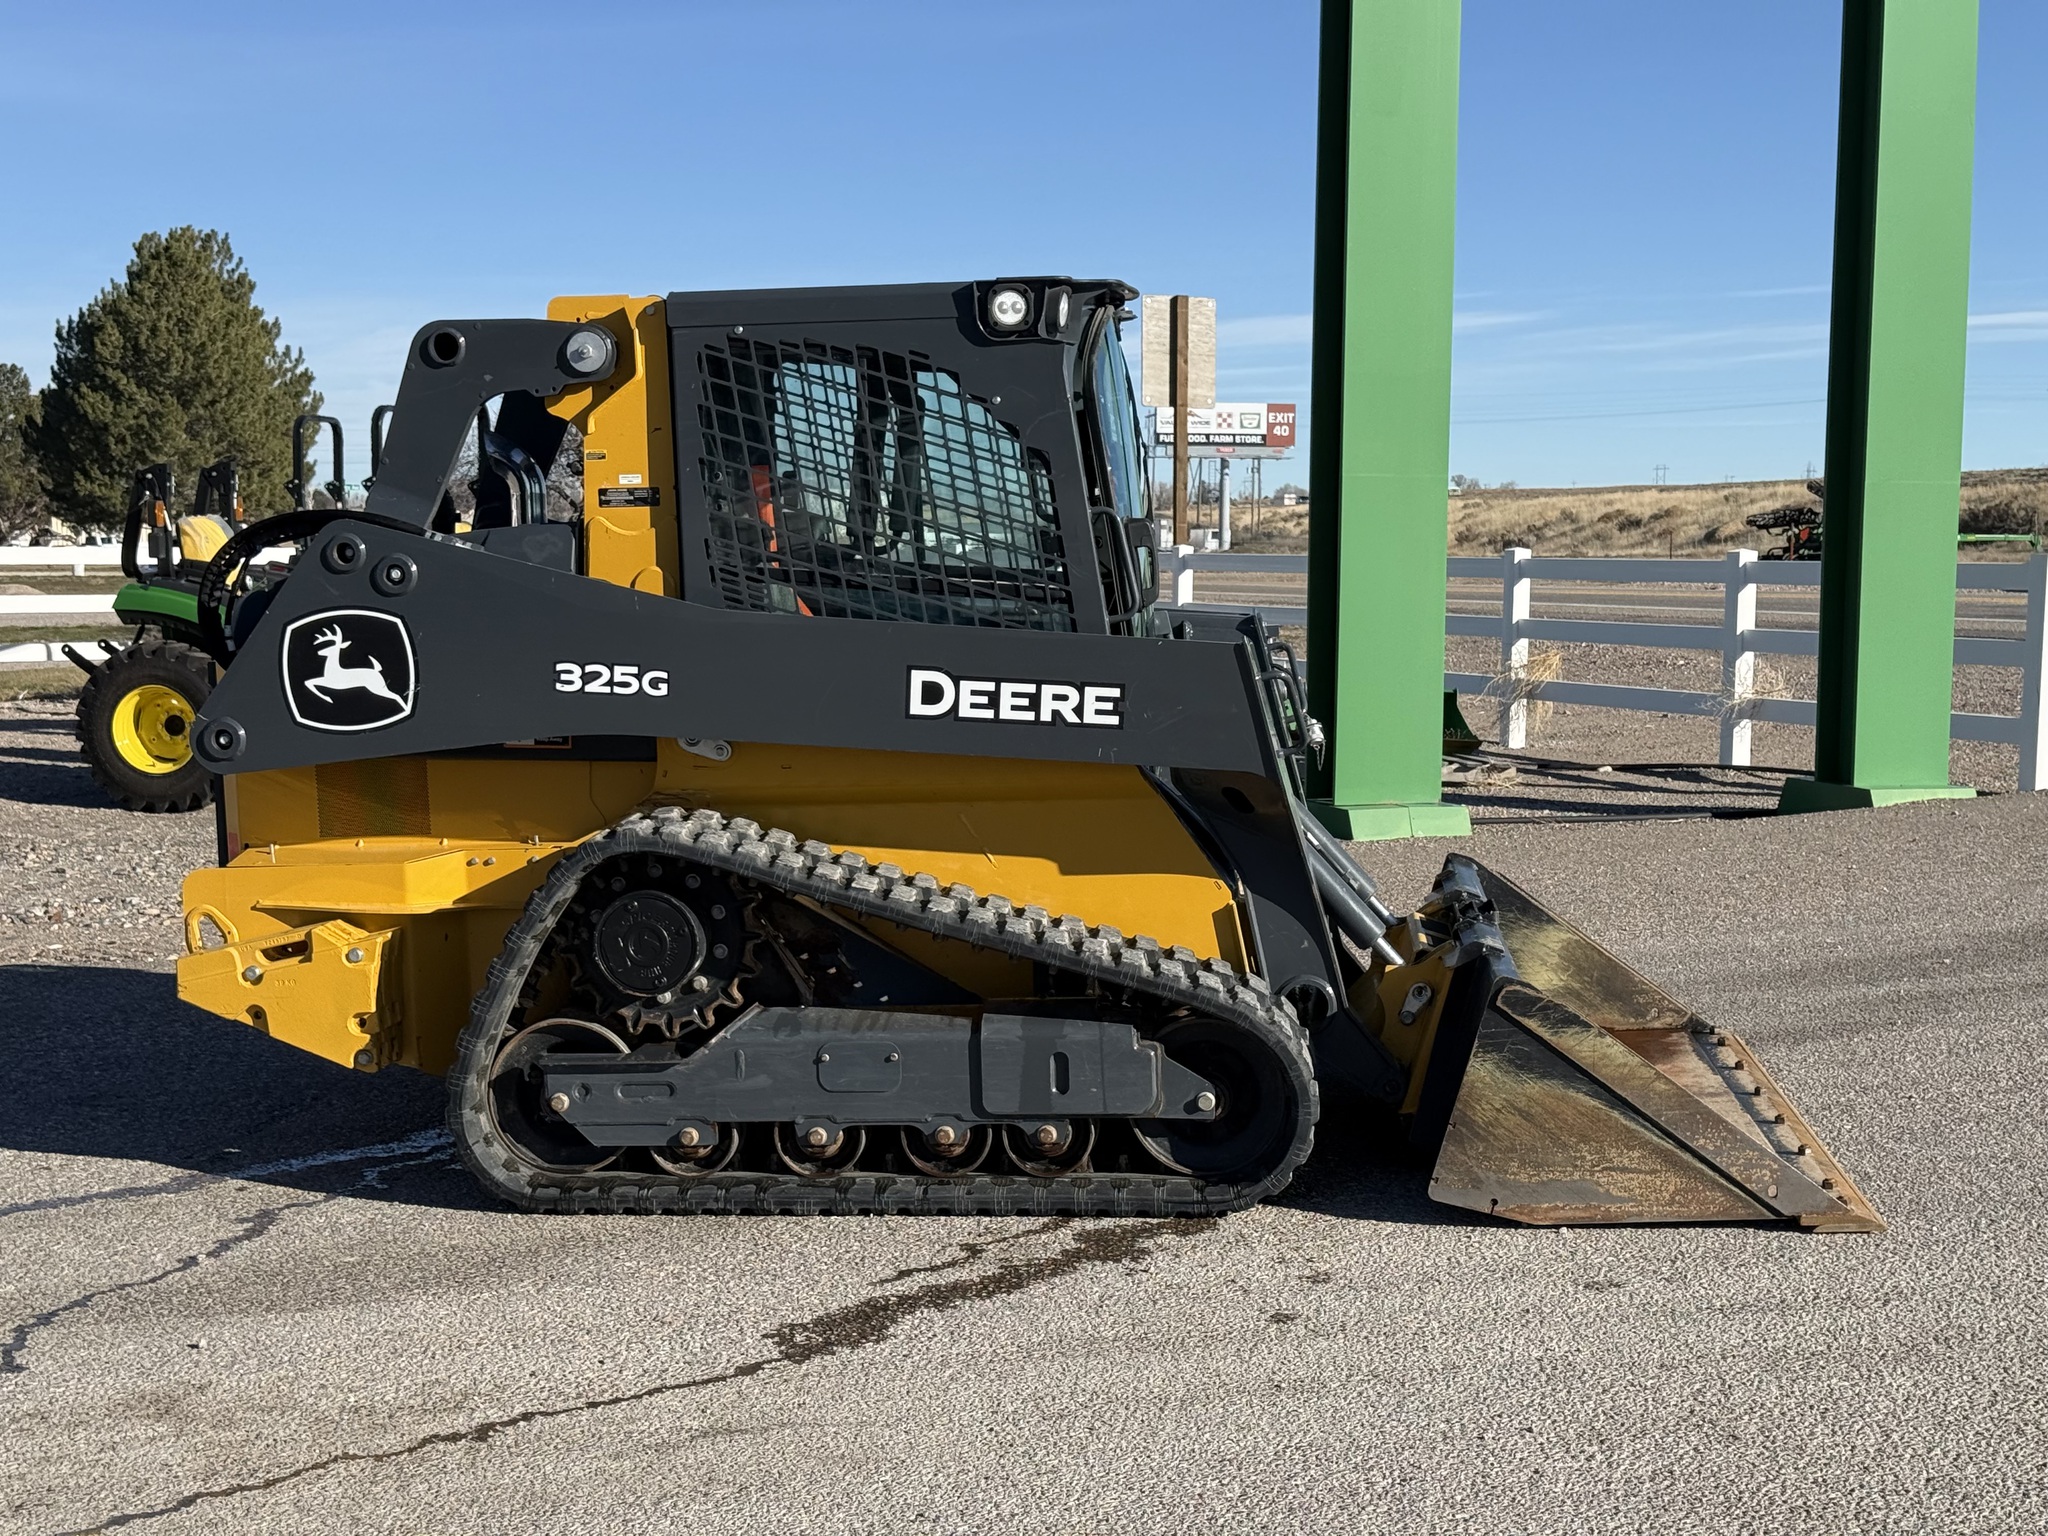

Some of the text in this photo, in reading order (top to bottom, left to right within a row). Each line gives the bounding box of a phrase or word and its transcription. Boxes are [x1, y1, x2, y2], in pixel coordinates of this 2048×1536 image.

[1268, 412, 1295, 424] EXIT
[1273, 425, 1290, 437] 40
[1159, 434, 1264, 444] FUE OOD. FARM STORE.
[555, 662, 669, 697] 325G
[908, 668, 1122, 726] DEERE
